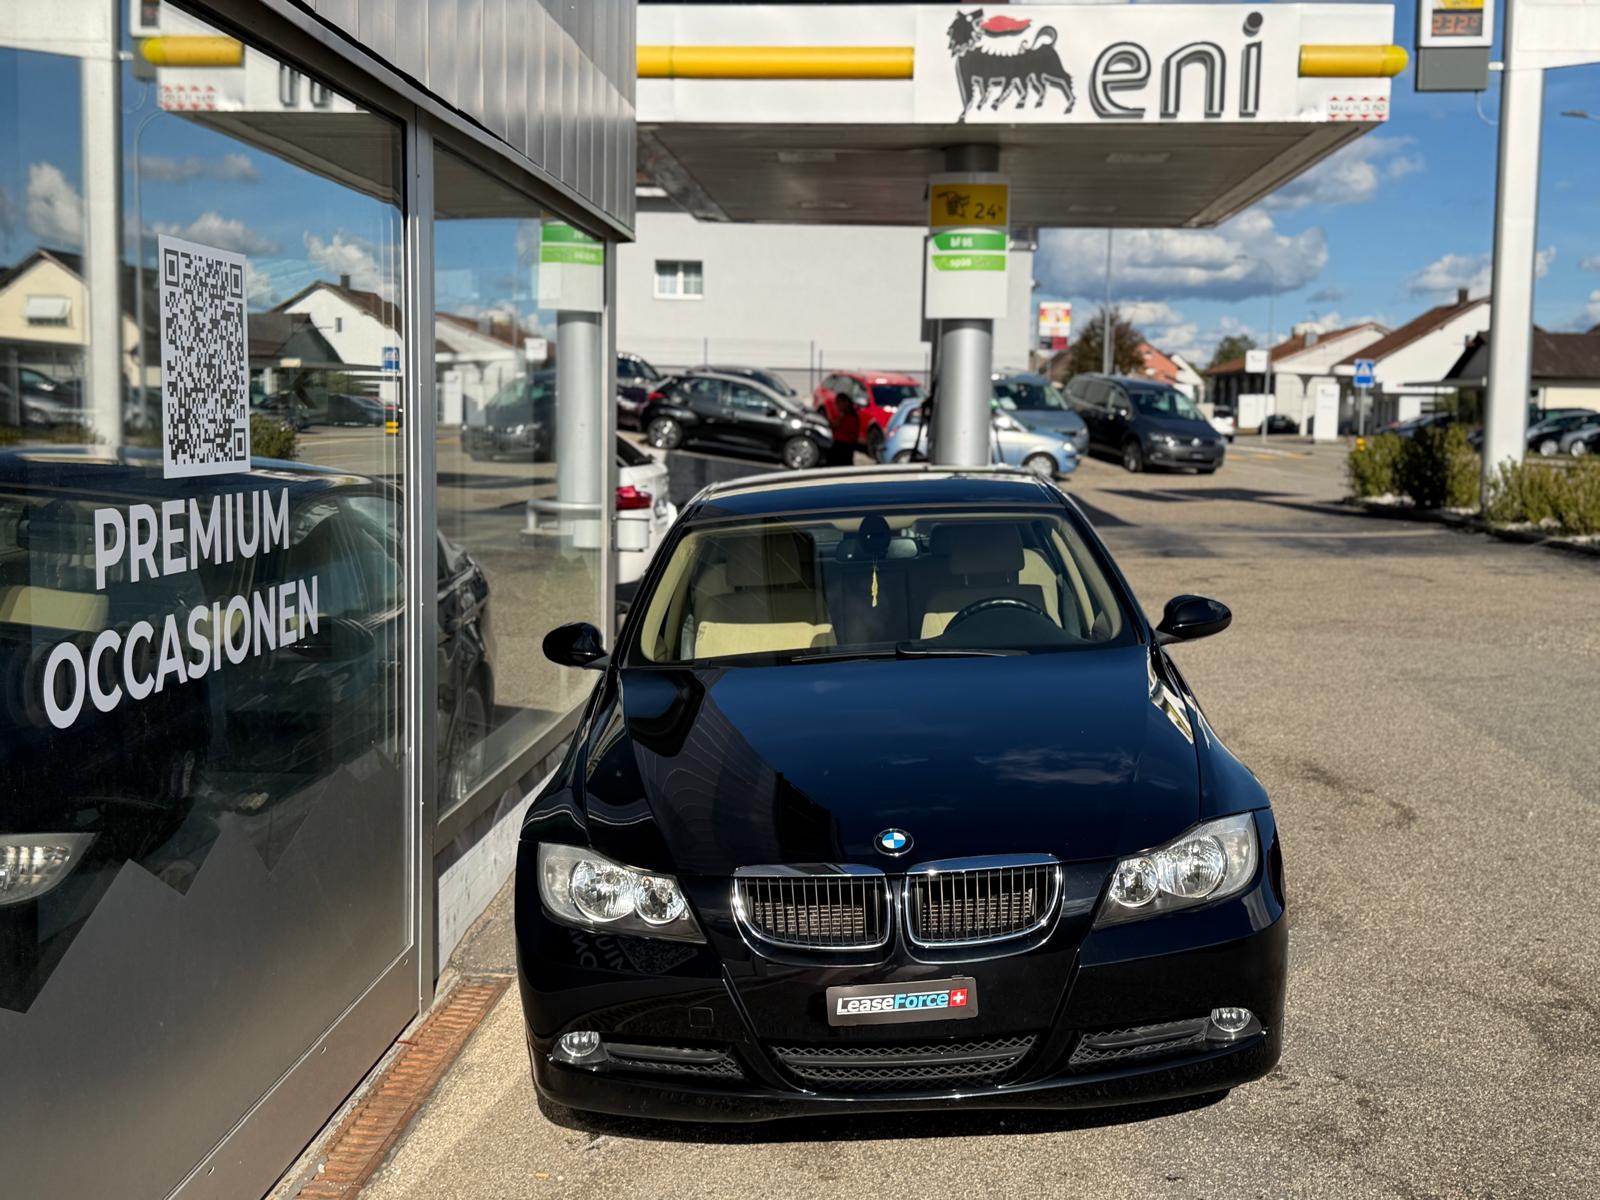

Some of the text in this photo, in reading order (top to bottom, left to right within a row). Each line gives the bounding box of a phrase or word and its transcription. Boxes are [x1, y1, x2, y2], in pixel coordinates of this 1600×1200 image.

[1089, 12, 1263, 119] eni
[95, 488, 290, 590] PREMIUM
[43, 575, 319, 729] OCCASIONEN
[837, 993, 949, 1014] LeaseForce
